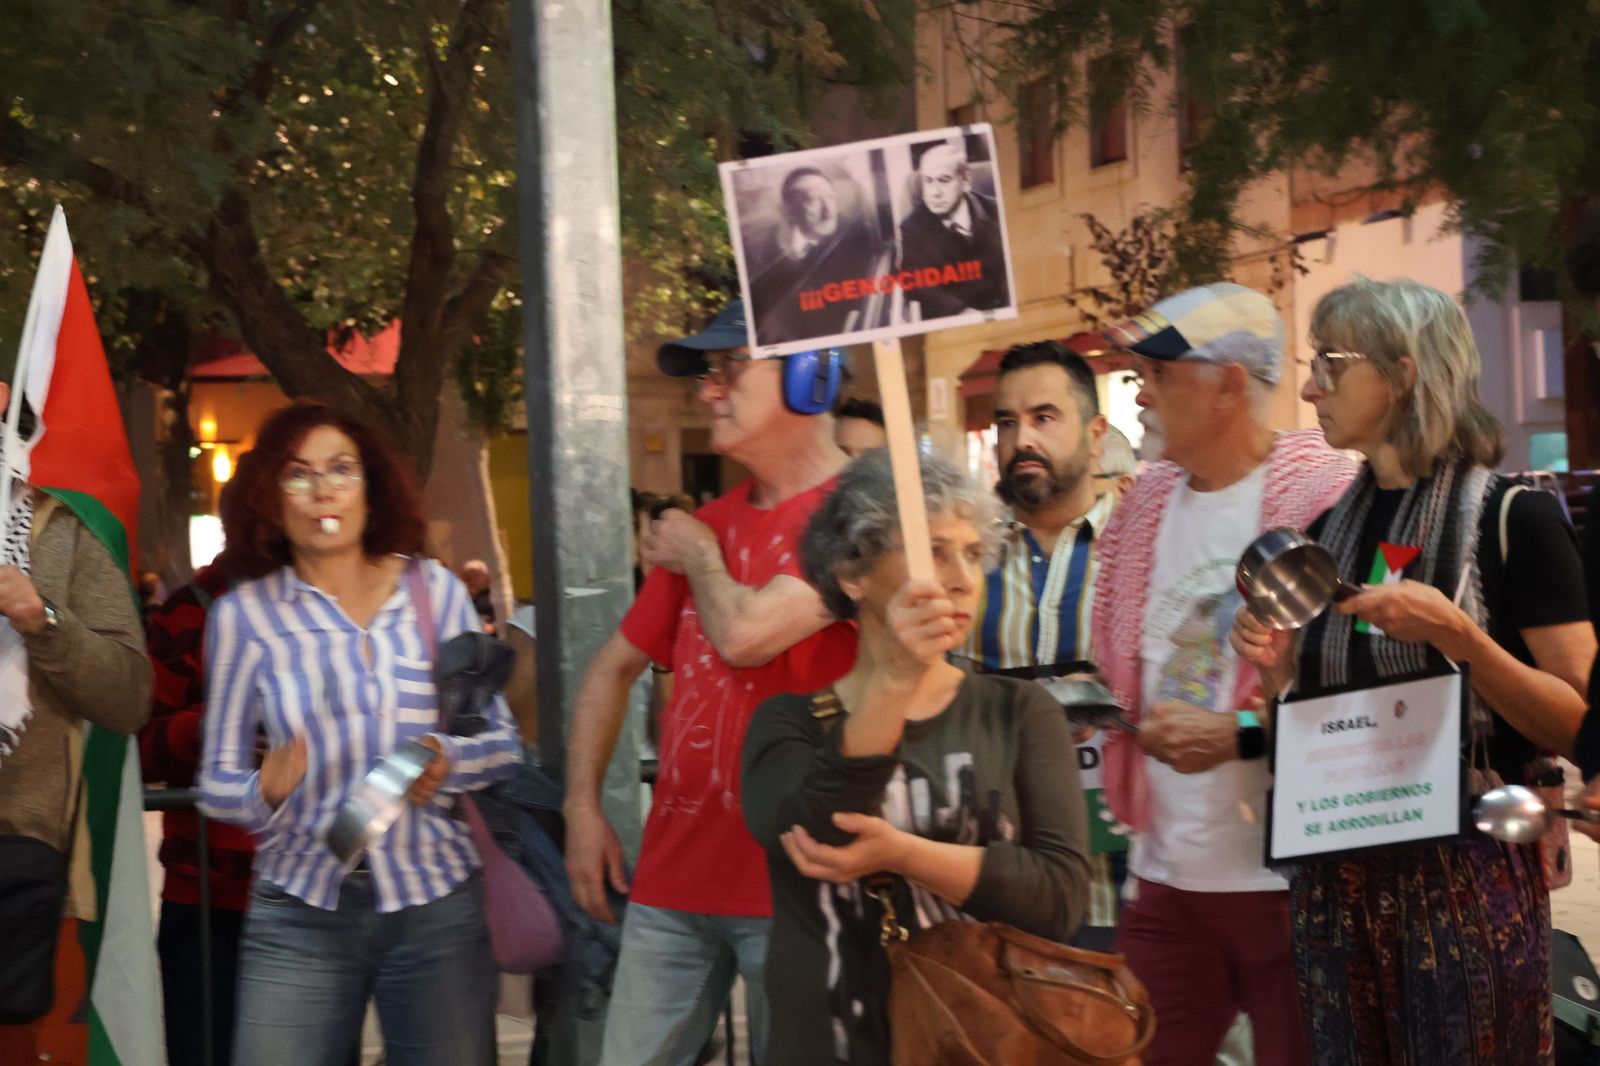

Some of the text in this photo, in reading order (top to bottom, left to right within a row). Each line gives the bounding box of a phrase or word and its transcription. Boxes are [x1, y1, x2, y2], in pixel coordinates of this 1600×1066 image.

[1297, 782, 1433, 814] Y LOS GOBIERNOS
[1304, 808, 1424, 836] SE ARRODILLAN
